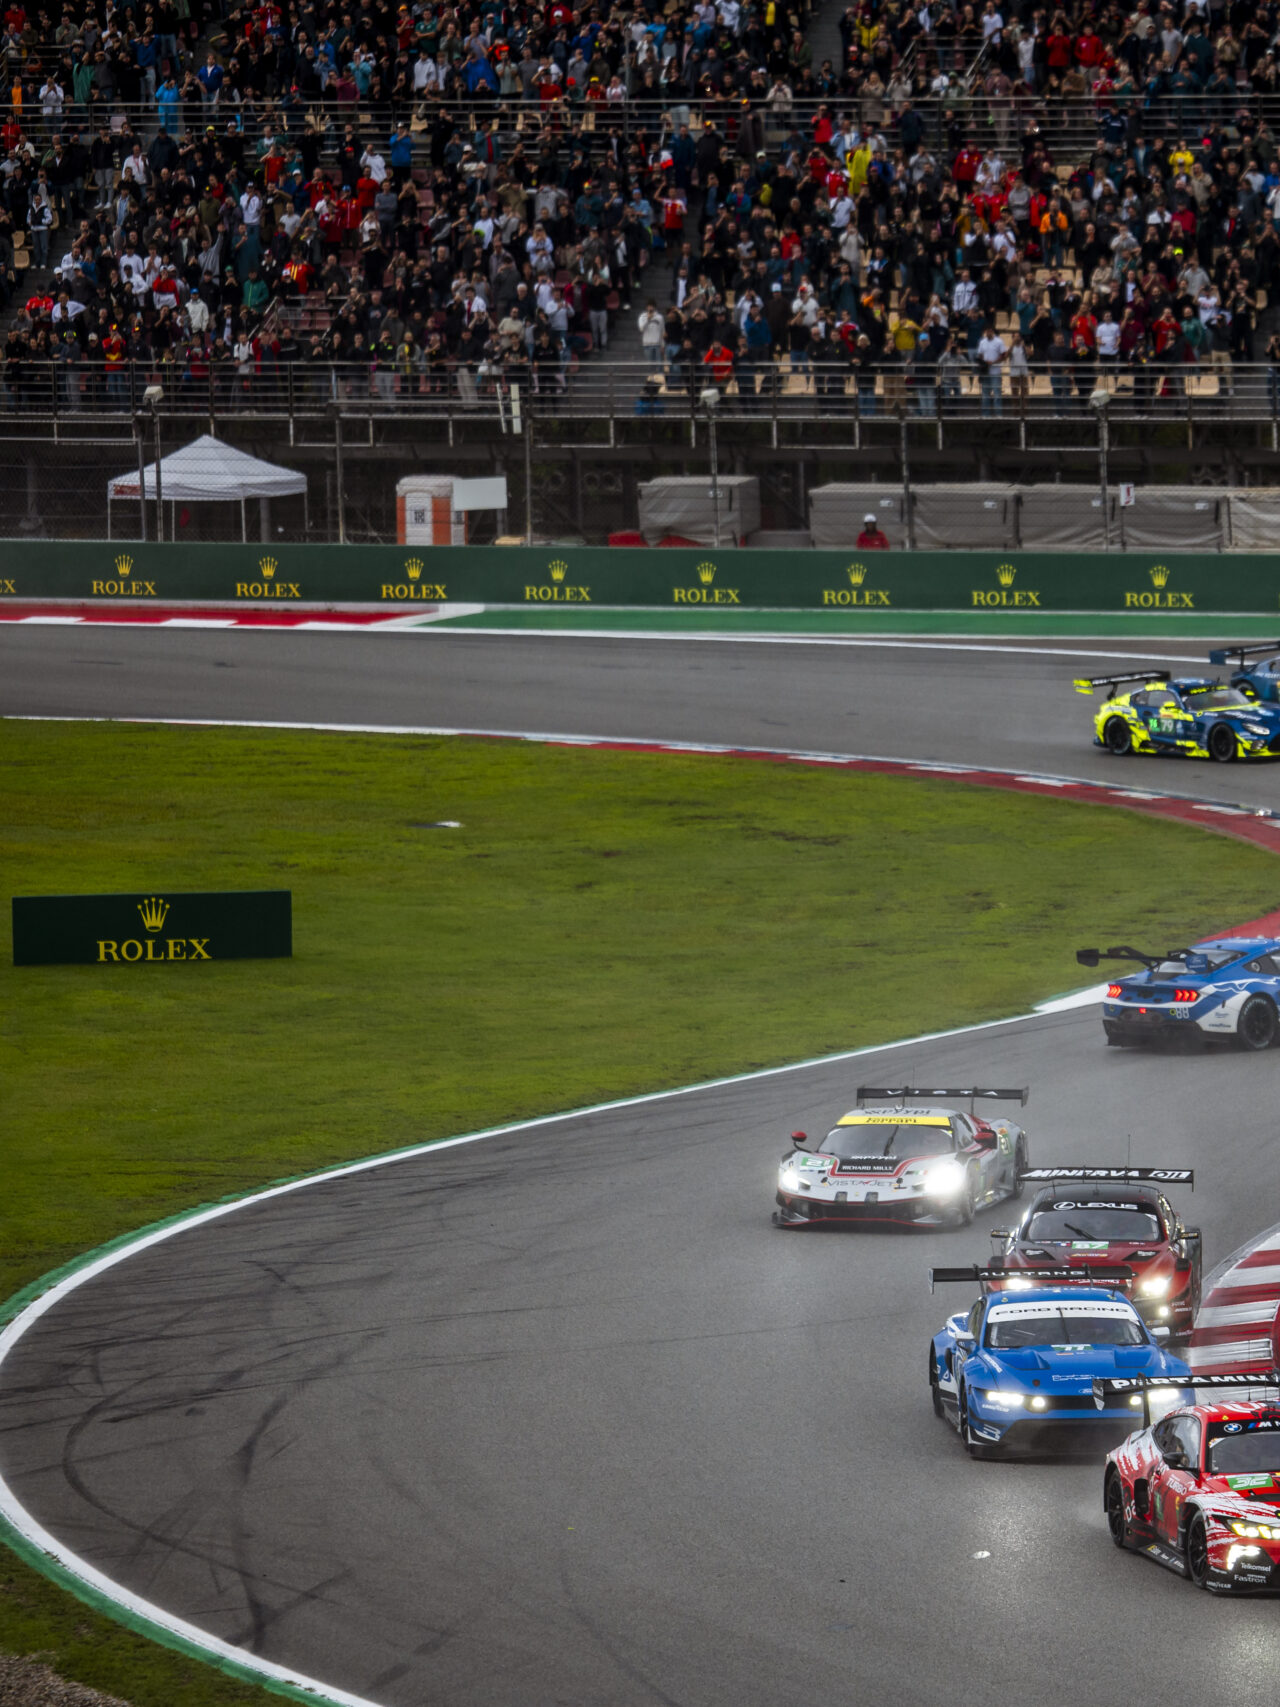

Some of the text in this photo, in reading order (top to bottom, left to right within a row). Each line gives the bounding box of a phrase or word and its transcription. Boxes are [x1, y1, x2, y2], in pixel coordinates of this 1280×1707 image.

[91, 579, 157, 596] ROLEX
[236, 582, 302, 598] ROLEX
[381, 584, 448, 600] ROLEX
[525, 586, 591, 601] ROLEX
[672, 588, 741, 604] ROLEX
[823, 589, 891, 605] ROLEX
[971, 591, 1041, 607] ROLEX
[1124, 593, 1194, 608] ROLEX
[1161, 720, 1174, 732] 79
[96, 938, 212, 962] ROLEX
[1175, 1007, 1190, 1019] 88
[1020, 1169, 1186, 1179] MINERVA OIL
[1077, 1202, 1138, 1210] LEXUS
[996, 1307, 1050, 1315] FORD
[1166, 1477, 1188, 1496] TURBO
[1241, 1562, 1271, 1572] Telkomsel
[1234, 1574, 1267, 1584] Fastron
